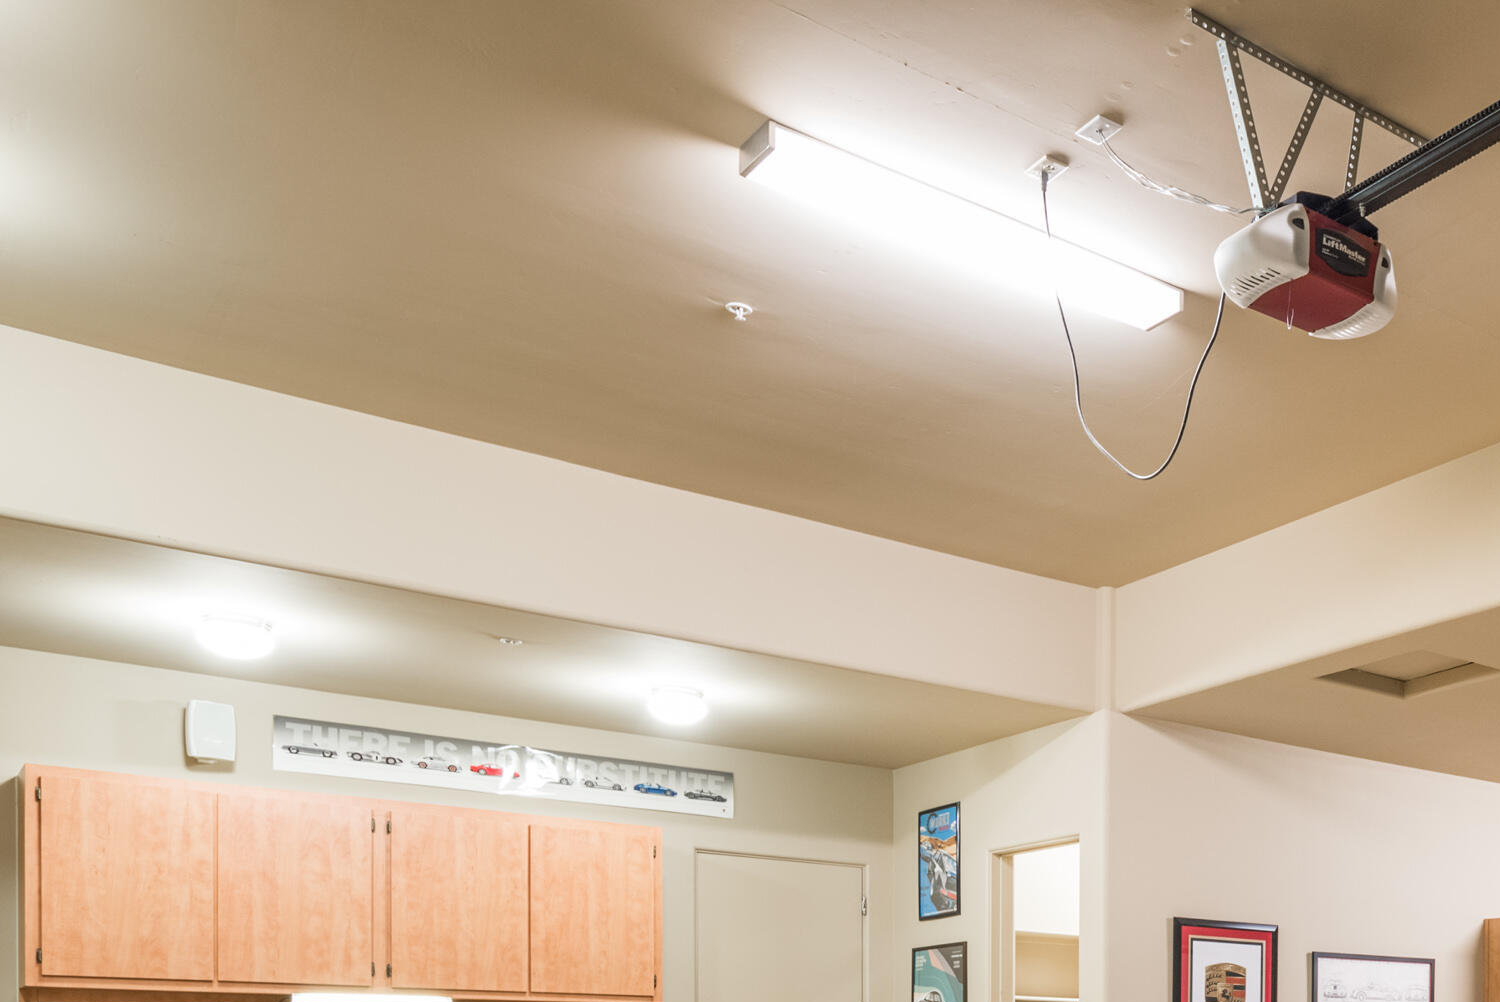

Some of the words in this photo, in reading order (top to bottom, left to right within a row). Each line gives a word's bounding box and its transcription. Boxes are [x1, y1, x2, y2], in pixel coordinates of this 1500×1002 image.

[1322, 236, 1366, 262] LiftMaster
[285, 721, 412, 754] THERE
[424, 739, 459, 761] IS
[471, 745, 521, 772] NO
[528, 751, 726, 790] UBSTITUTE
